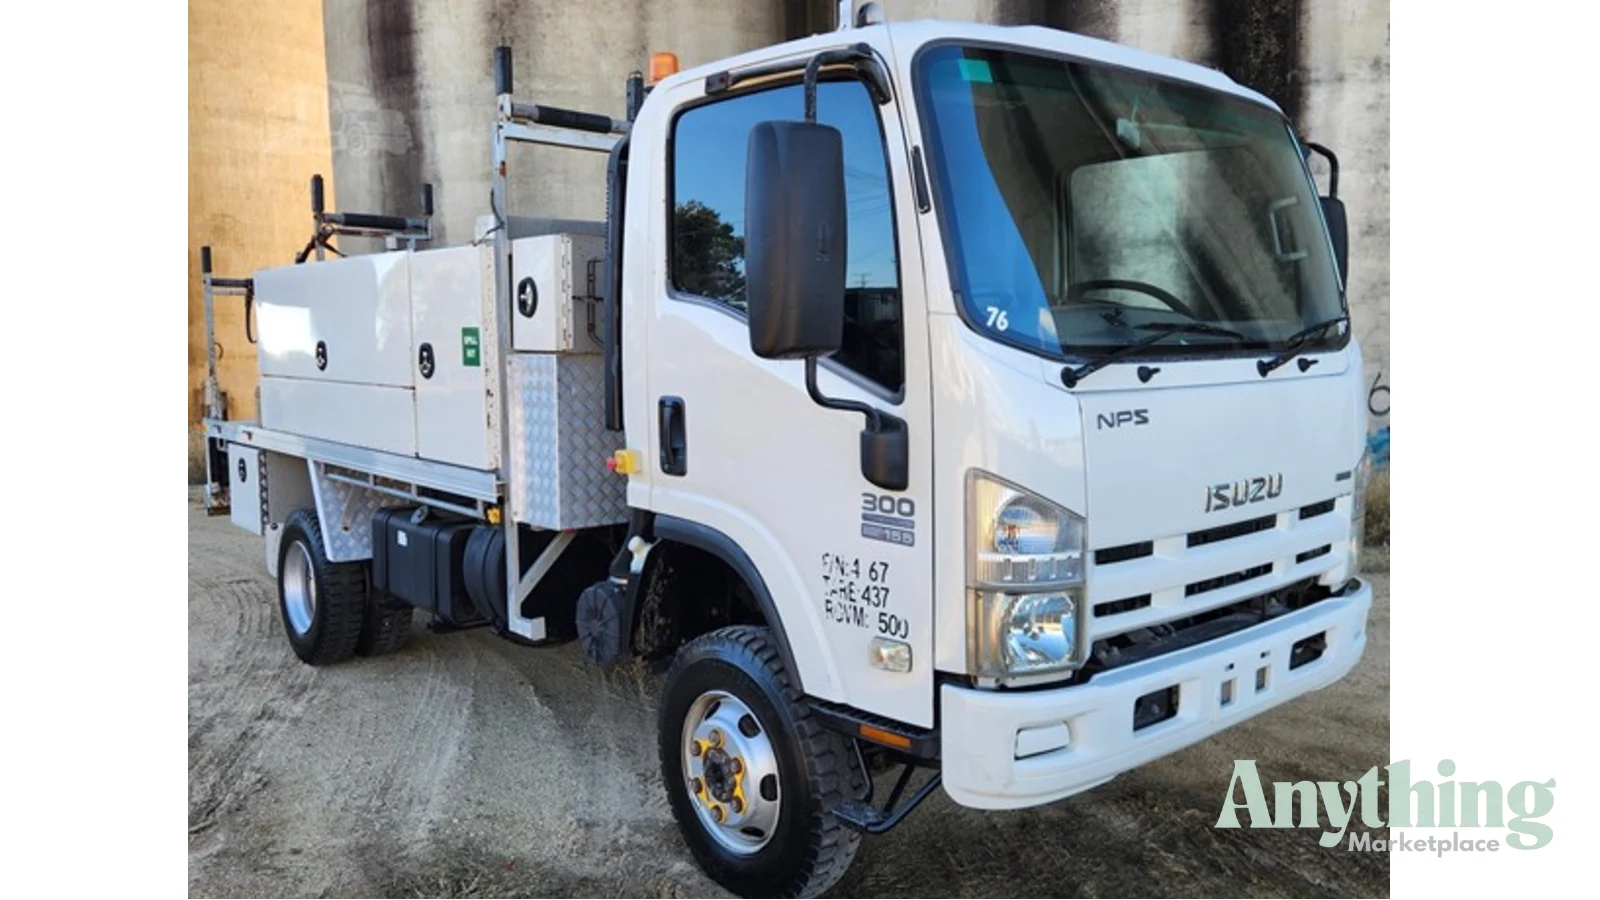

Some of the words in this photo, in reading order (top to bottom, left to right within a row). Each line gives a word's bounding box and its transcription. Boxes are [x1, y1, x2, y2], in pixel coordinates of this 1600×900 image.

[987, 306, 1009, 331] 76
[1097, 409, 1149, 430] NPS
[861, 492, 915, 517] 300
[1205, 472, 1283, 513] ISUZU
[868, 561, 889, 583] 67
